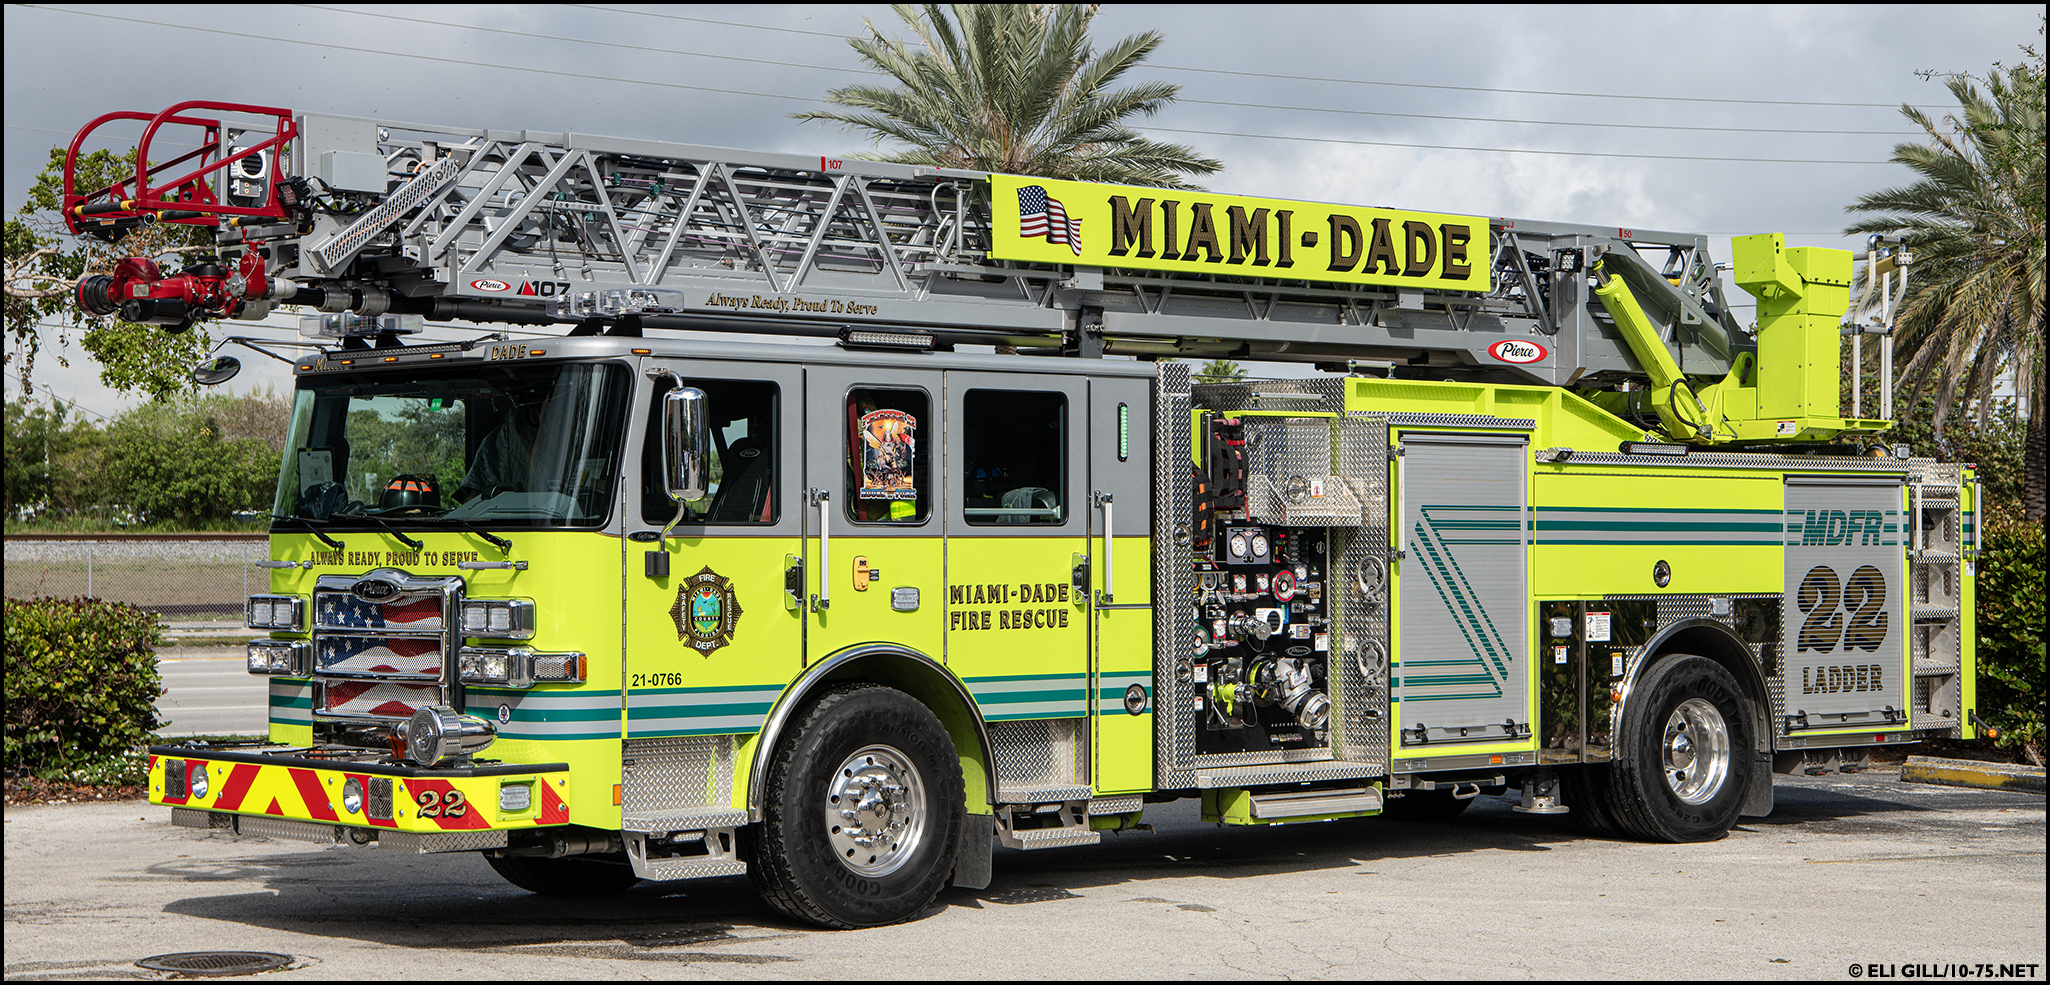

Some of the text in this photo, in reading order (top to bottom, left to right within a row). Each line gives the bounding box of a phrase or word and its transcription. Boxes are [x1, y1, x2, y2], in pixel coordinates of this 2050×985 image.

[828, 160, 843, 170] 107
[1107, 195, 1473, 281] MIAMI-DADE
[1623, 229, 1633, 239] 50
[530, 280, 572, 297] 107
[705, 292, 879, 316] Always Ready, Proud To Serve
[491, 344, 528, 360] DADE
[1501, 342, 1535, 359] Pierce
[1801, 509, 1884, 547] MDFR
[310, 551, 345, 566] ALWAYS
[348, 551, 382, 568] READY,
[386, 551, 420, 566] PROUD
[424, 551, 438, 566] TO
[698, 573, 716, 583] FIRE
[362, 580, 390, 599] Pierce
[949, 583, 1069, 605] MIAMI-DADE
[1796, 564, 1889, 655] 22
[950, 608, 1069, 631] FIRE RESCUE
[694, 628, 719, 638] FLORIDA
[695, 640, 719, 650] DEPT.
[631, 672, 682, 687] 21-0766
[1802, 664, 1884, 695] LADDER
[878, 722, 926, 751] ARMOR
[416, 789, 468, 819] 22
